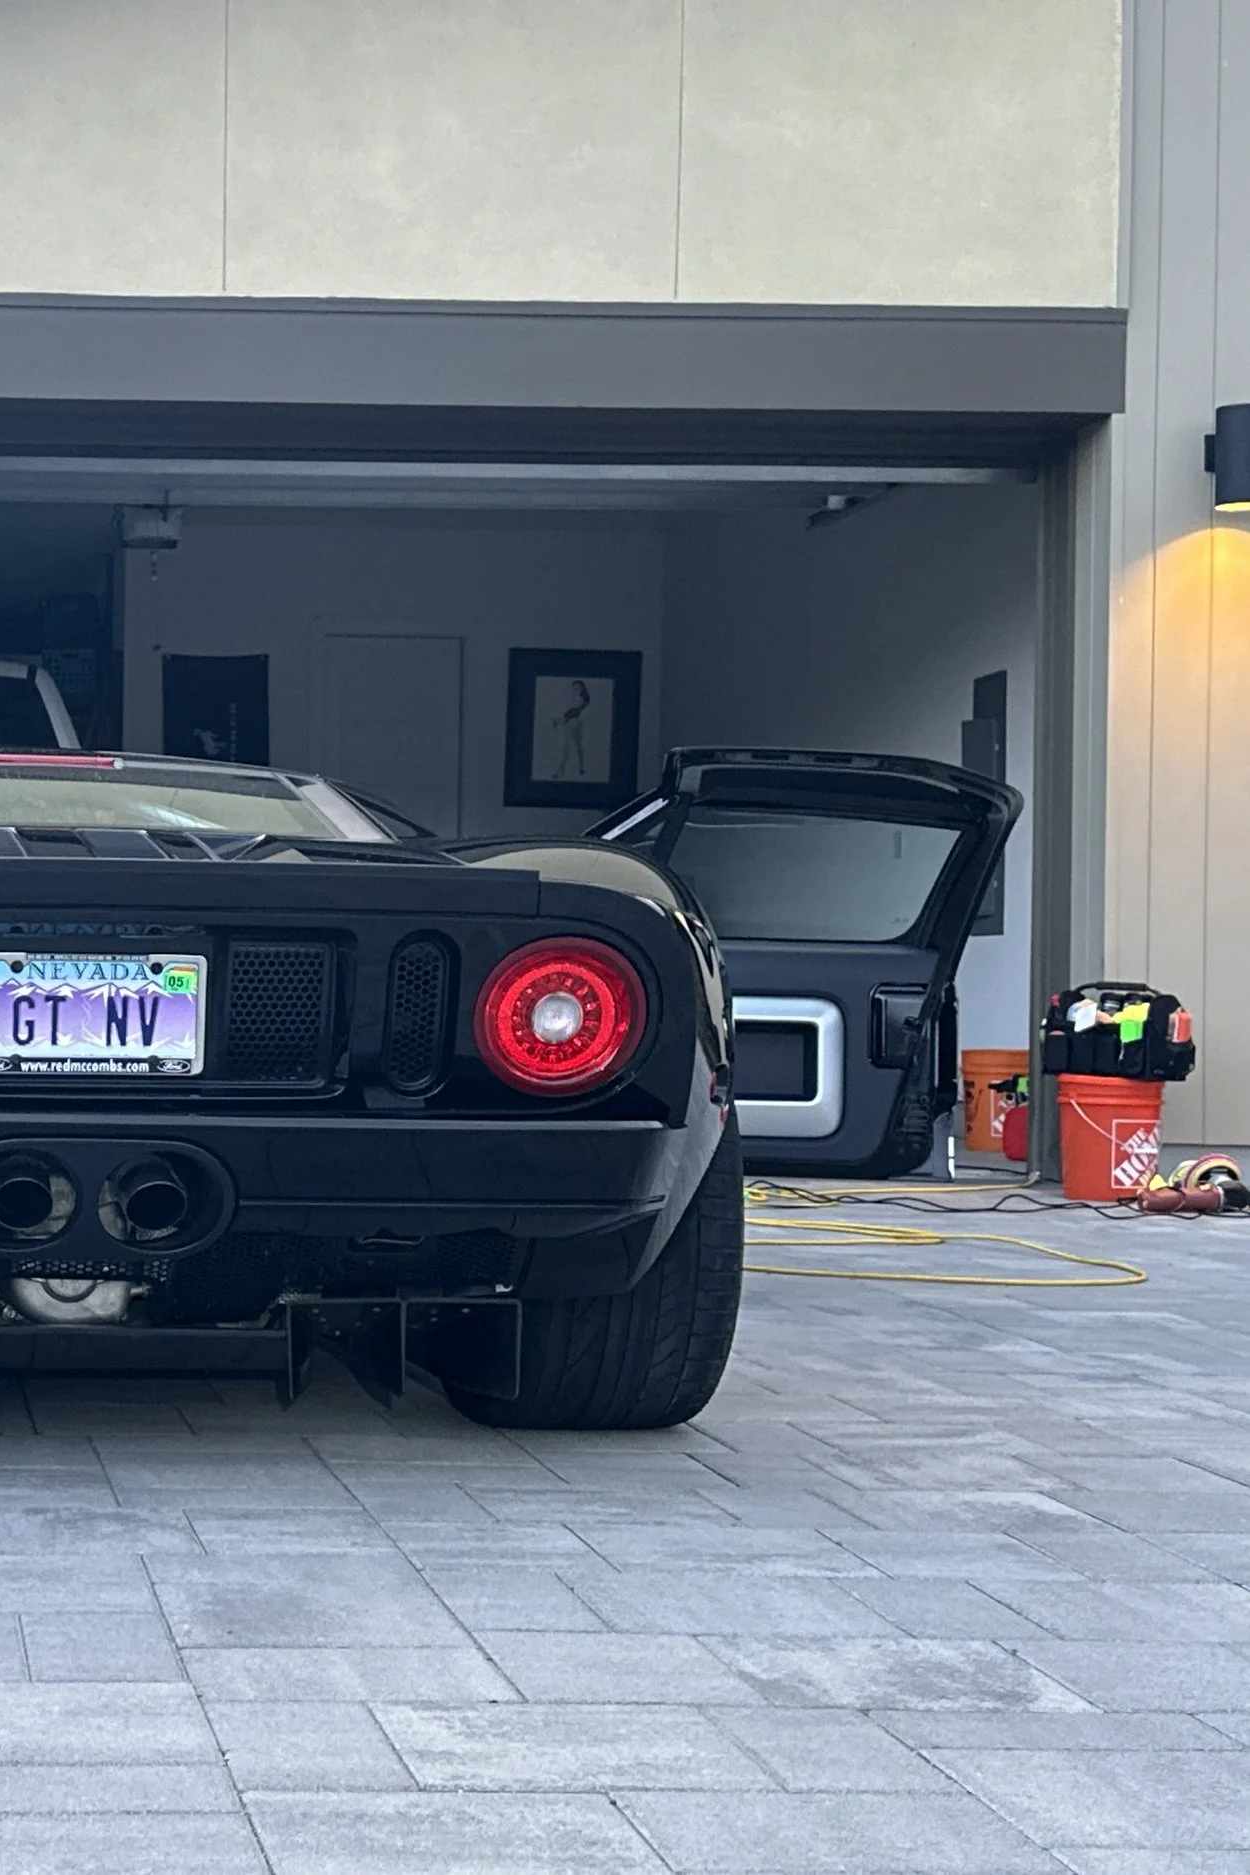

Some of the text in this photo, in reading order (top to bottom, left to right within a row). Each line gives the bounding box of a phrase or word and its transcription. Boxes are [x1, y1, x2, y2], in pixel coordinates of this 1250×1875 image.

[27, 962, 149, 980] NEVADA
[168, 975, 184, 988] 05
[12, 995, 159, 1047] GT NV
[19, 1058, 149, 1072] www.redmccombs.com
